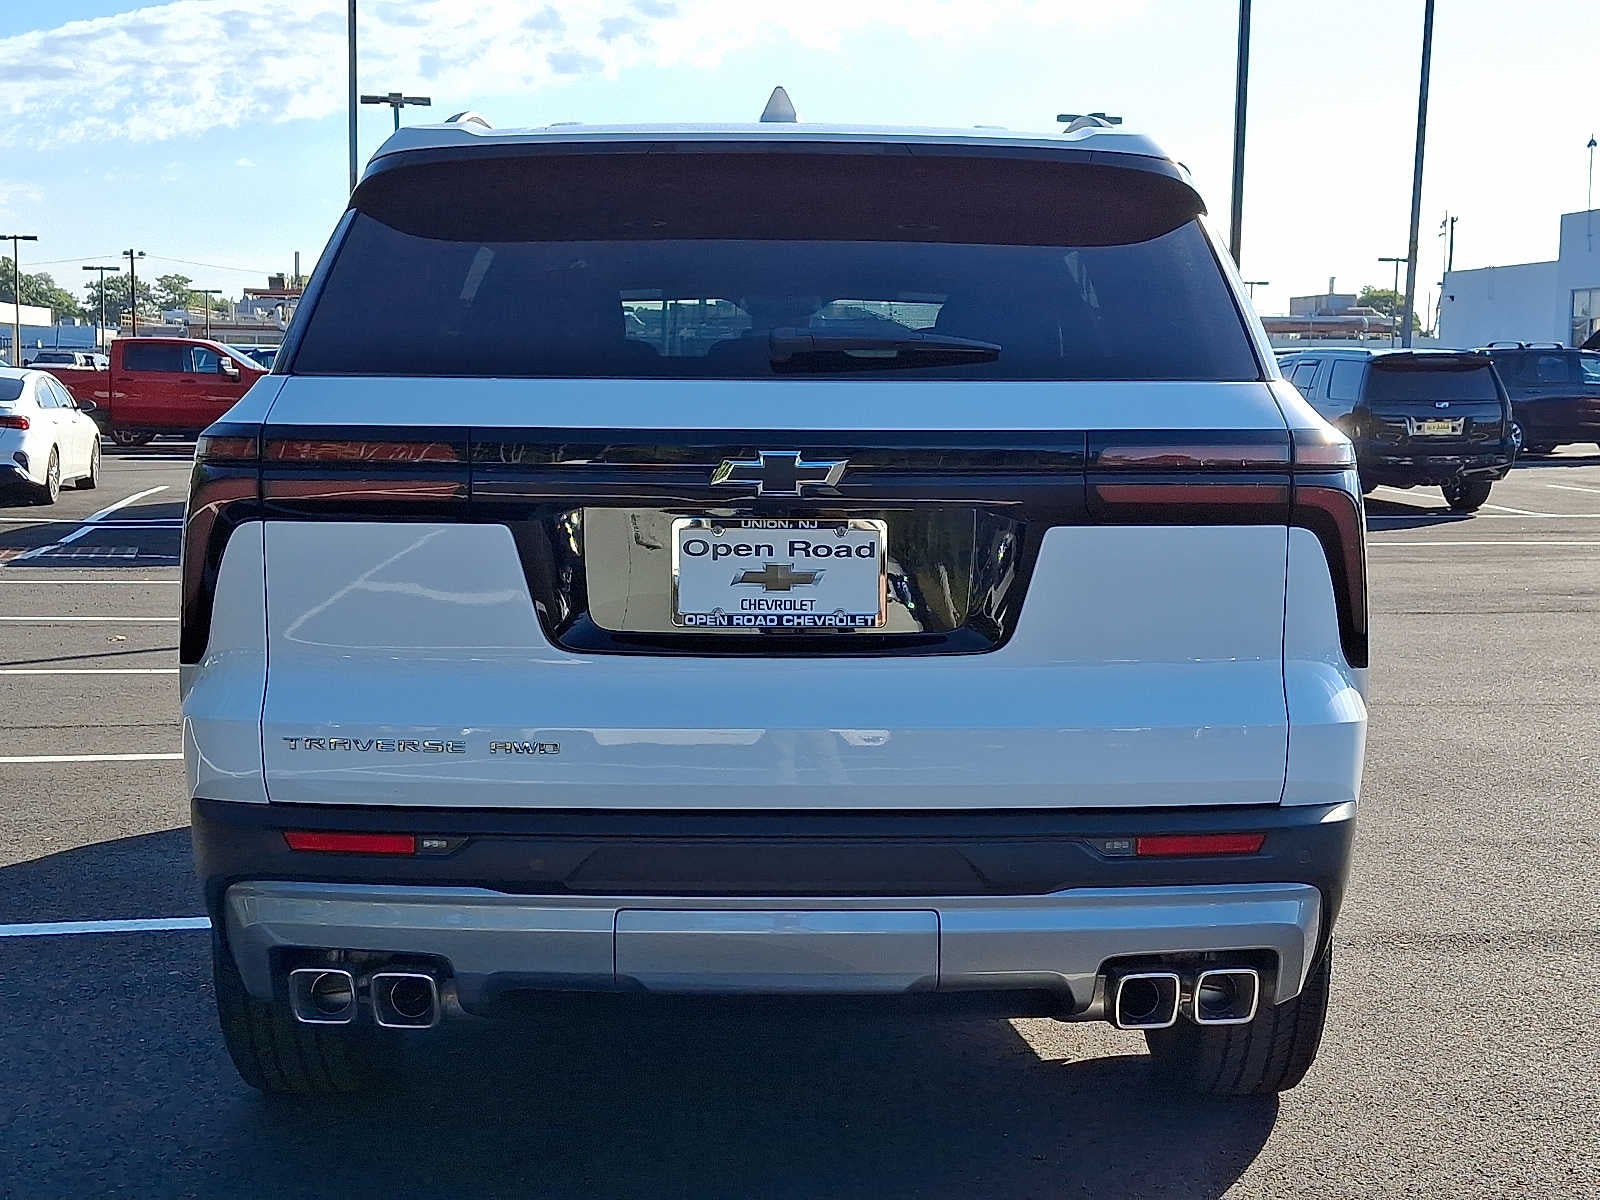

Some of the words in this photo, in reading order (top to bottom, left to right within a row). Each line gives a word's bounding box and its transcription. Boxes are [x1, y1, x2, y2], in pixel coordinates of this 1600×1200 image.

[797, 519, 818, 529] NJ
[682, 539, 774, 560] Open
[788, 540, 876, 558] Road
[740, 598, 816, 611] CHEVROLET
[684, 614, 728, 626] OPEN
[732, 614, 777, 626] ROAD
[782, 614, 875, 626] CHEVROLET
[282, 737, 467, 754] TRAVERSE
[490, 741, 560, 754] AWD
